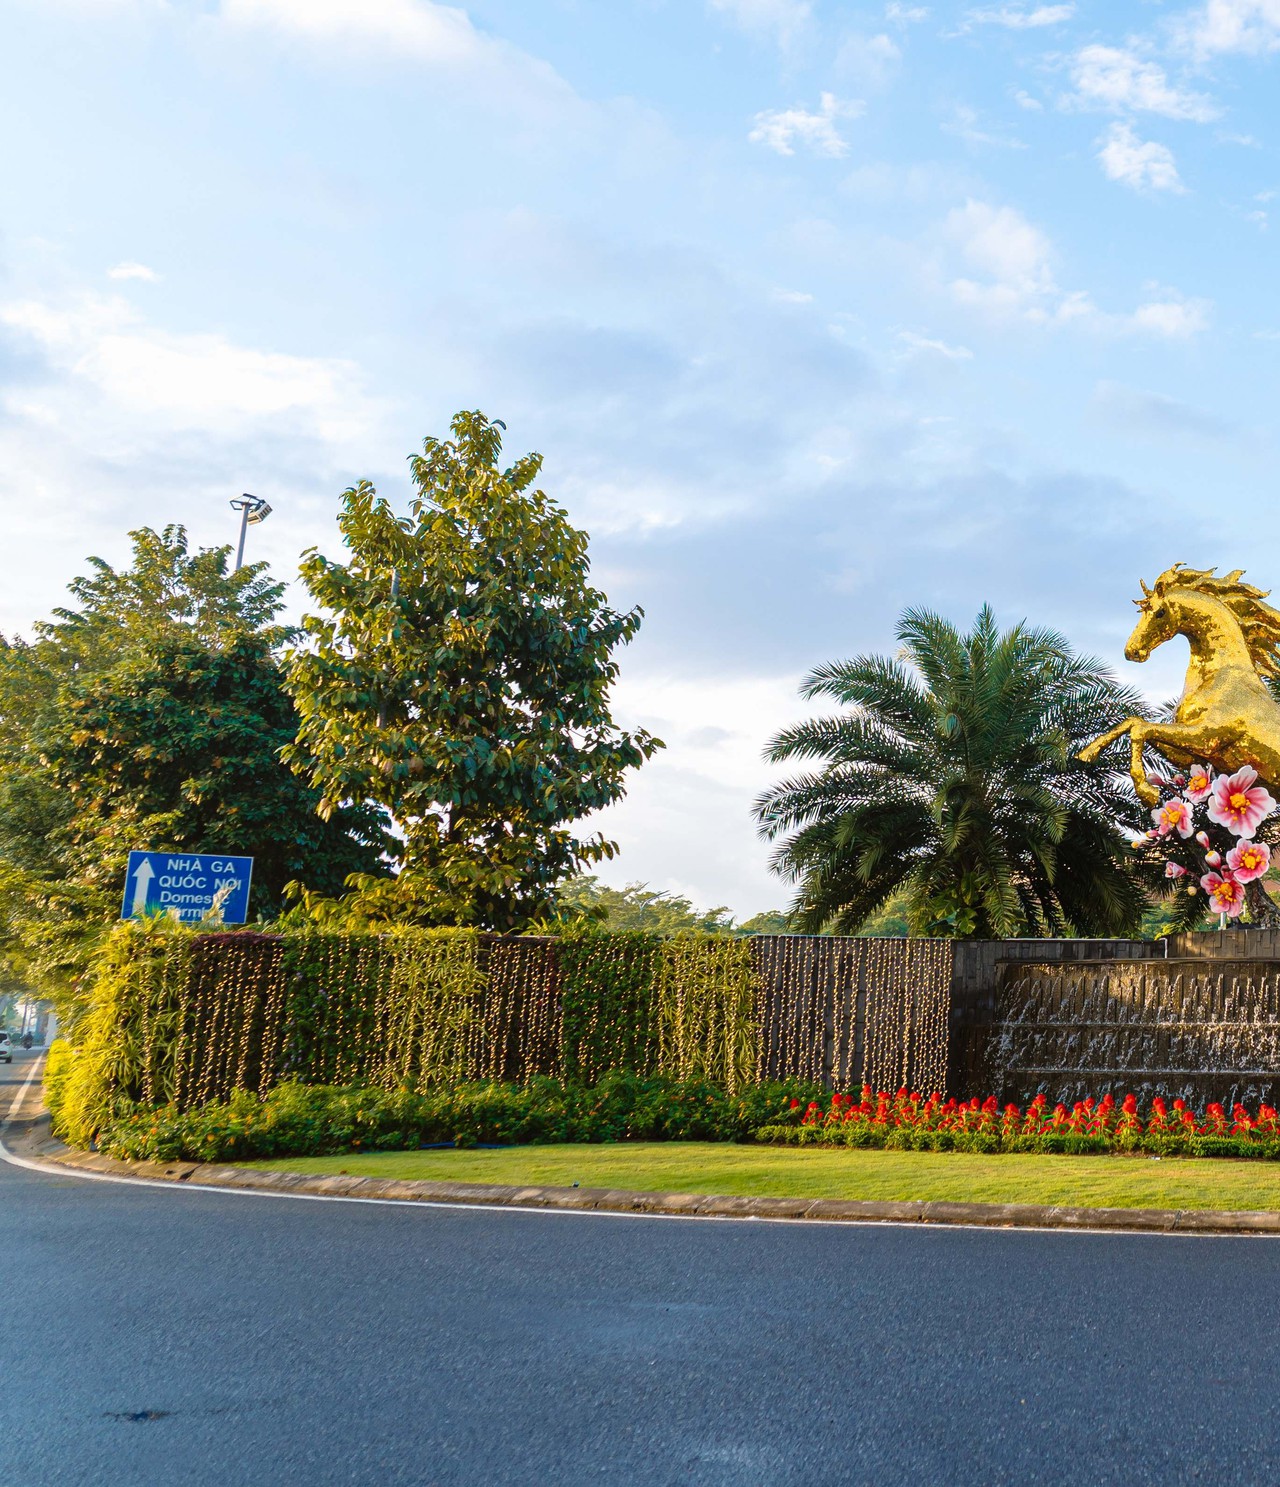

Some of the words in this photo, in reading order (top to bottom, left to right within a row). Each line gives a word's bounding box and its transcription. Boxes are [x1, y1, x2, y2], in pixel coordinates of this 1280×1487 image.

[167, 858, 203, 872] NHÀ
[211, 861, 235, 873] GA
[160, 891, 230, 905] Domesc
